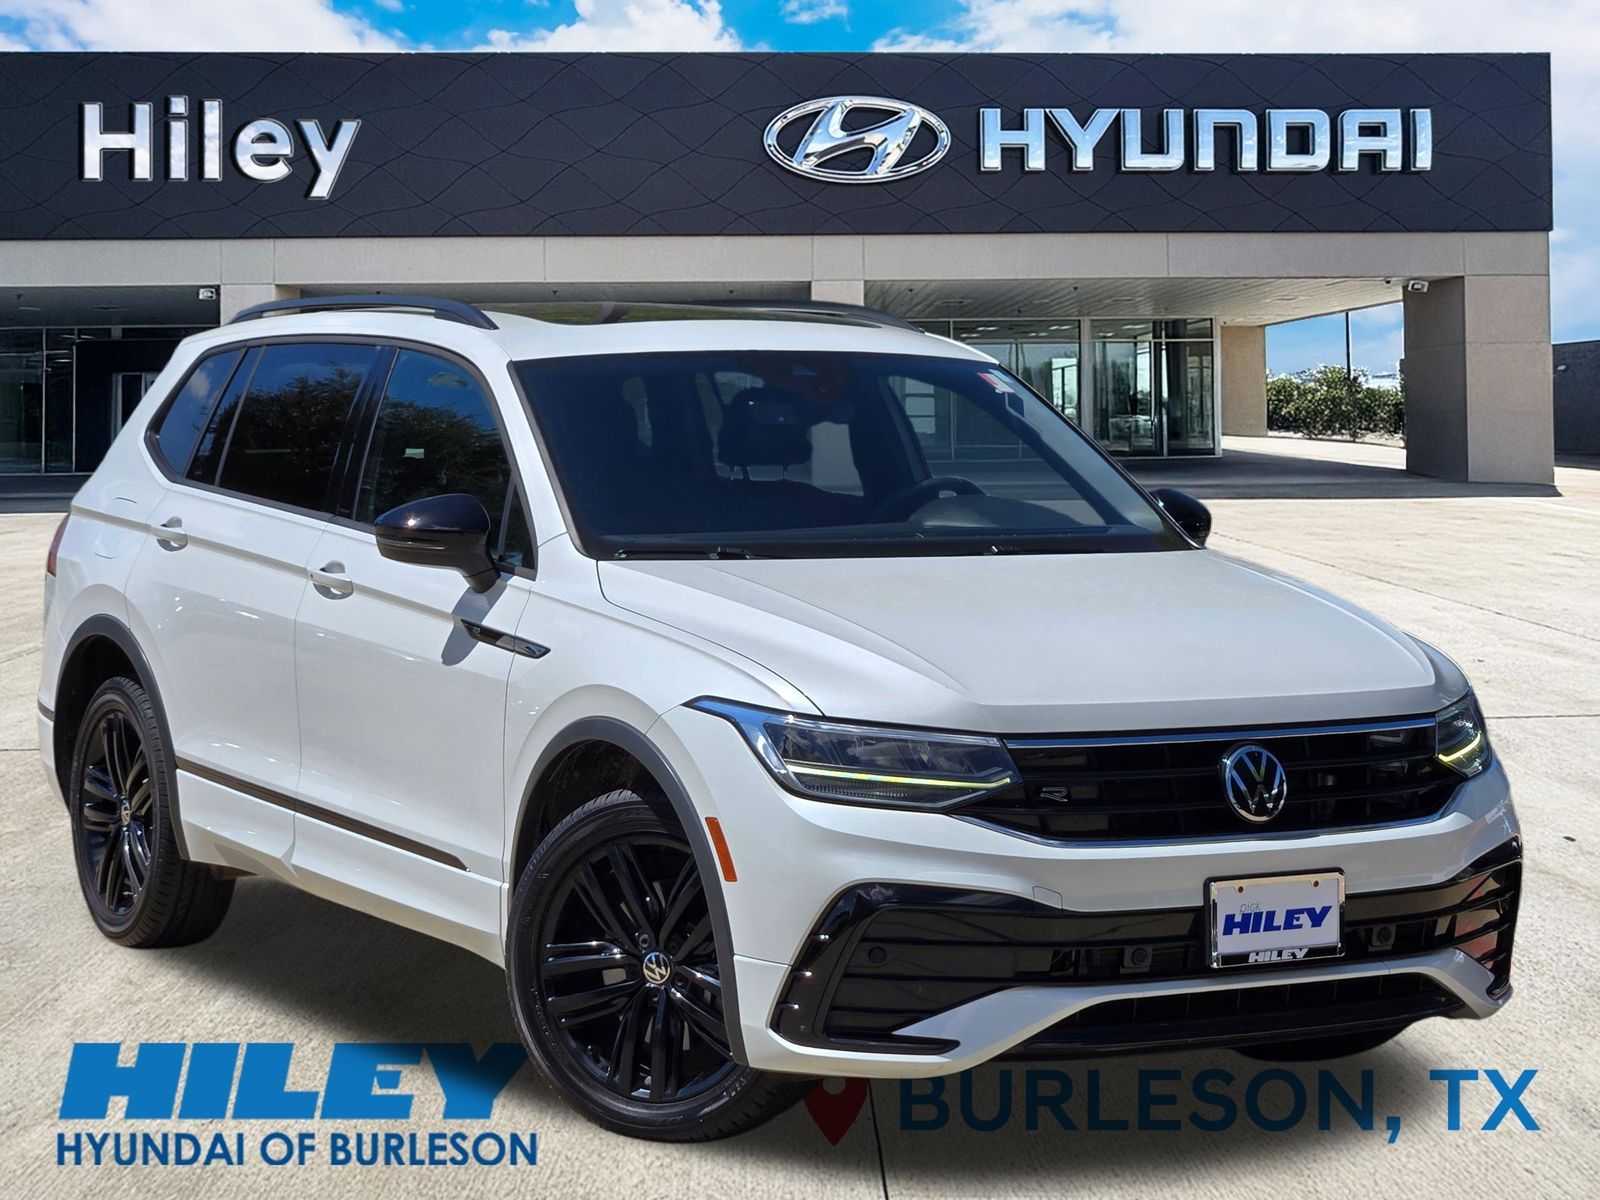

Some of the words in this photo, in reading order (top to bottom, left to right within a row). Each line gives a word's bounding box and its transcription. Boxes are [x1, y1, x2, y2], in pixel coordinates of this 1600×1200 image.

[81, 95, 361, 199] Hiley
[980, 107, 1434, 172] HYUNDAI
[1222, 905, 1333, 936] HILEY
[1248, 948, 1309, 963] HILEY
